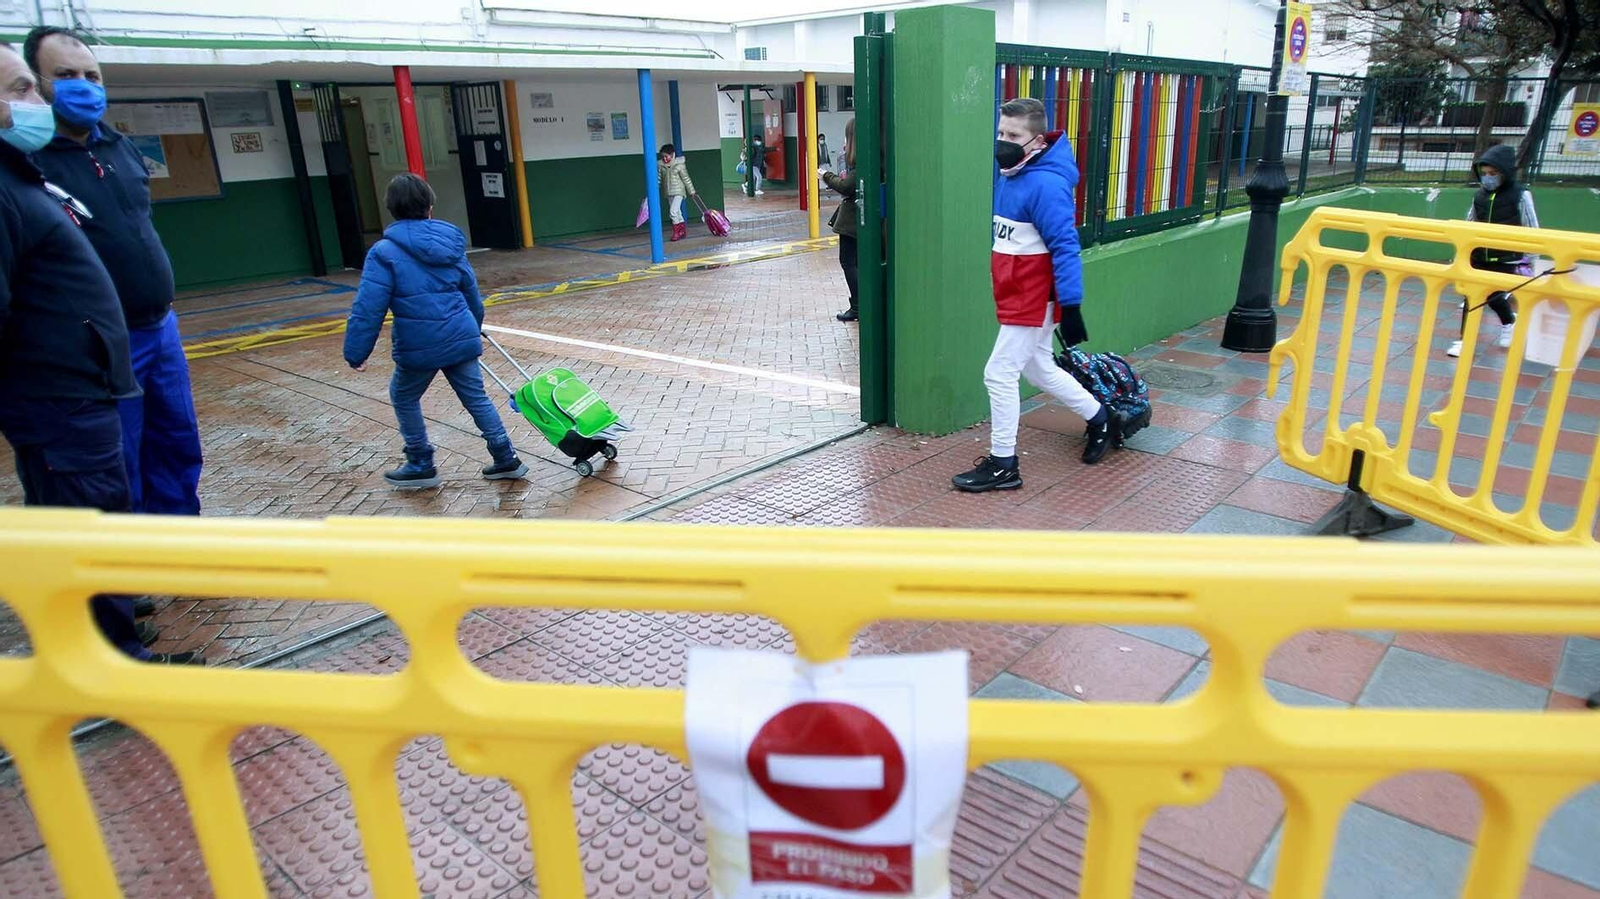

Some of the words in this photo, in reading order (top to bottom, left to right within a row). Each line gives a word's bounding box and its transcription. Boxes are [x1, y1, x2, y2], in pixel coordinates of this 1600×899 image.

[772, 841, 889, 871] PROHIBIDO
[788, 861, 810, 876] EL
[819, 863, 876, 885] PASO
